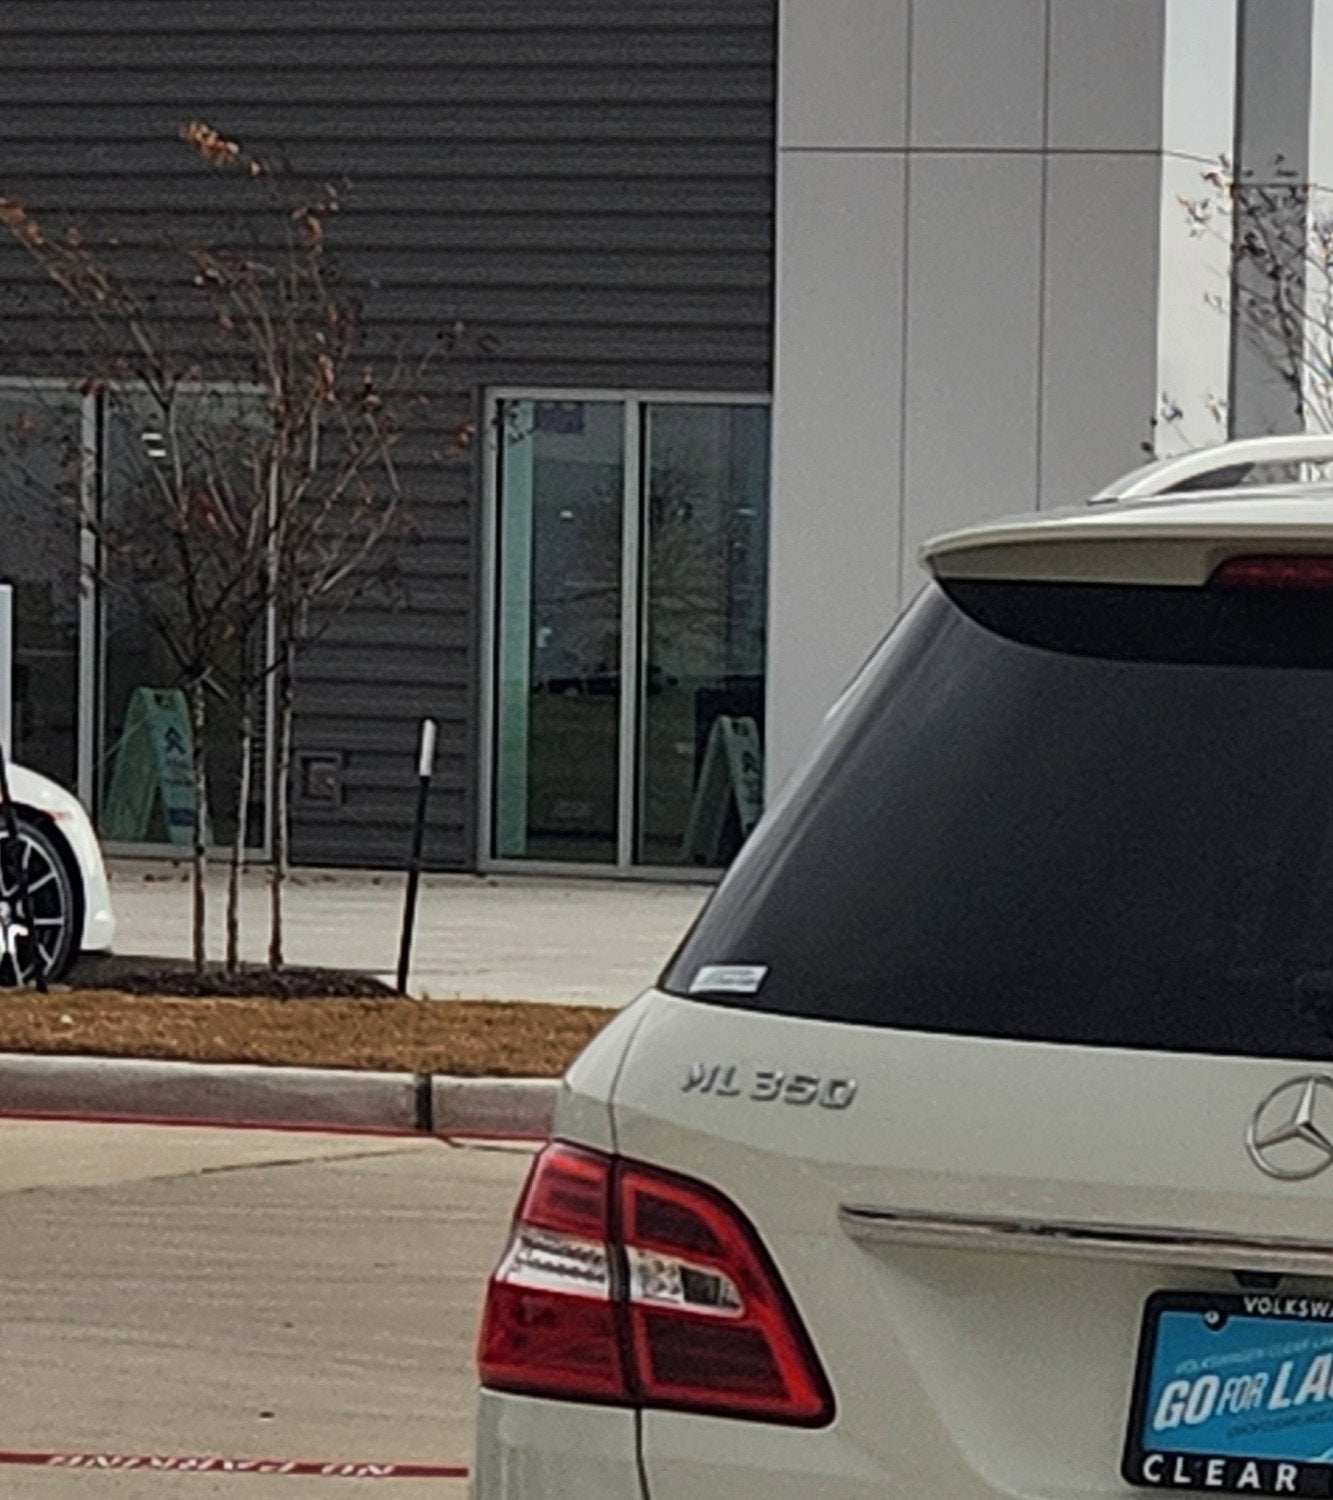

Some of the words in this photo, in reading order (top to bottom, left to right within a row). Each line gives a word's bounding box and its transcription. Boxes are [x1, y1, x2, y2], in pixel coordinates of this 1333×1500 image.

[680, 1061, 741, 1098] ML
[749, 1068, 858, 1111] 350
[1152, 1374, 1222, 1432] GO
[1215, 1371, 1268, 1416] FOR
[1142, 1453, 1298, 1493] CLEAR
